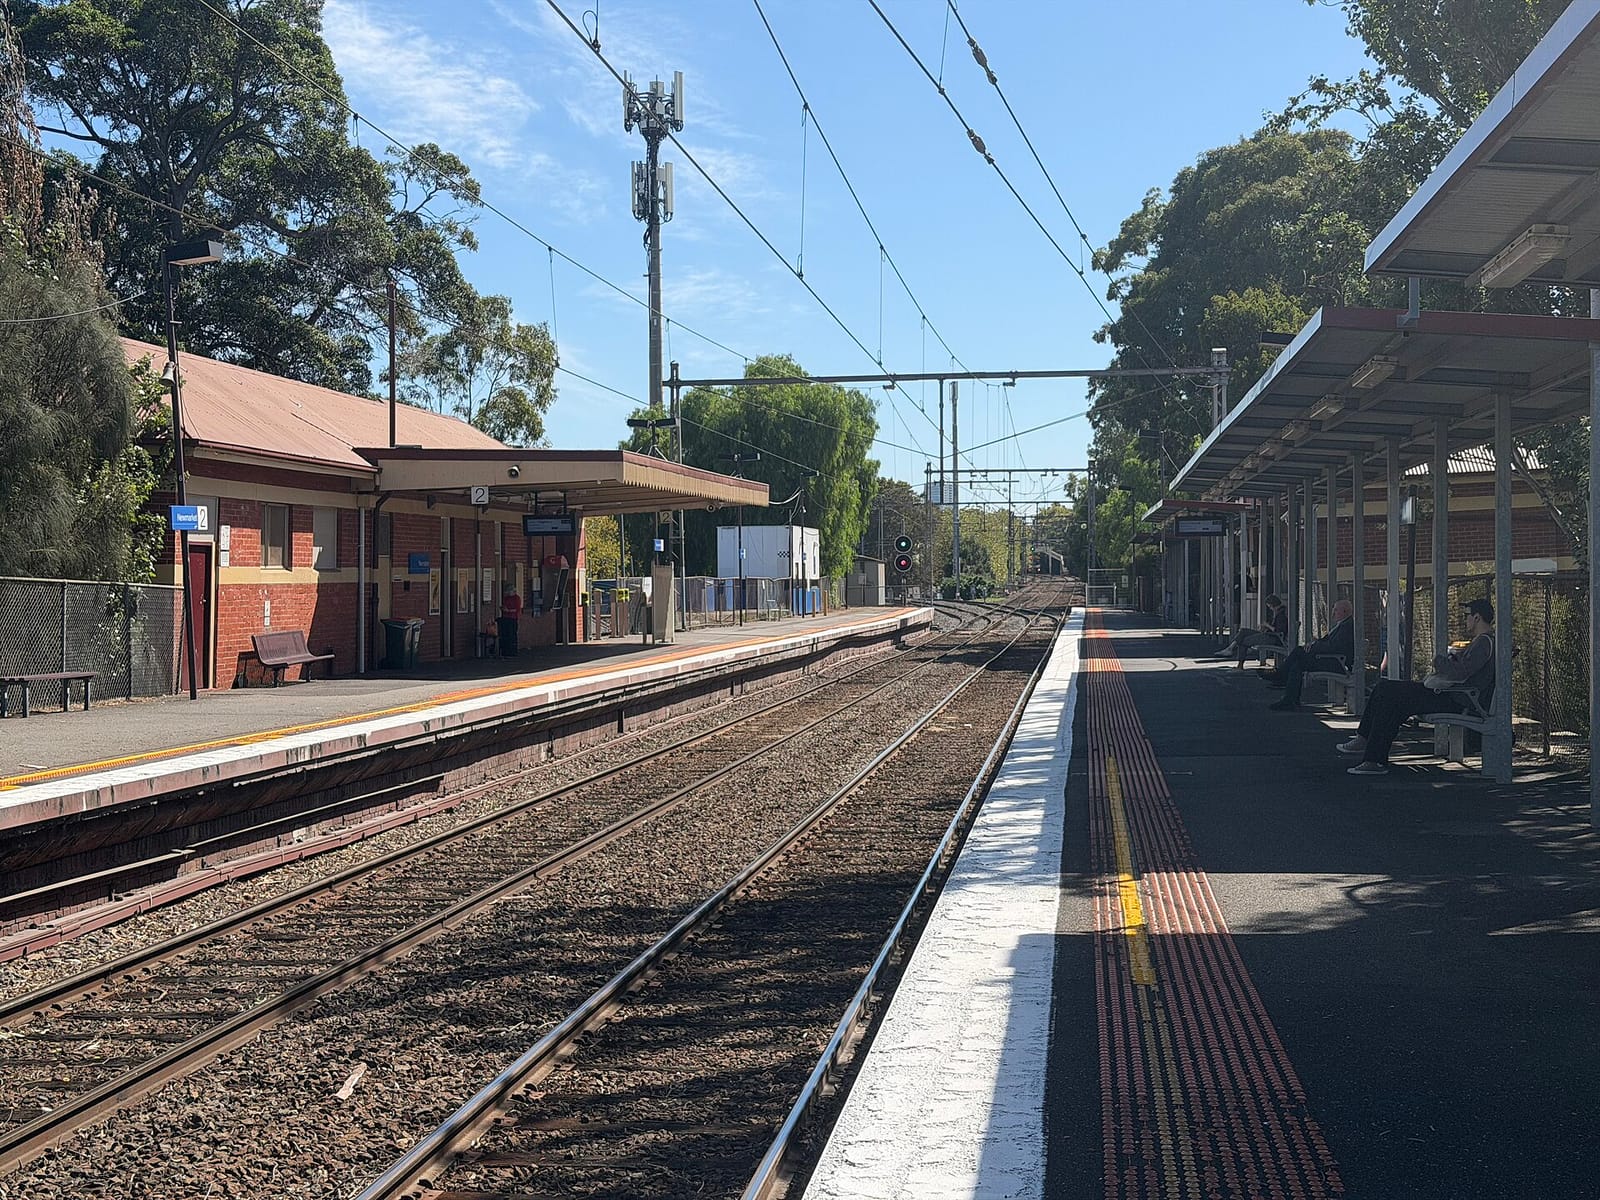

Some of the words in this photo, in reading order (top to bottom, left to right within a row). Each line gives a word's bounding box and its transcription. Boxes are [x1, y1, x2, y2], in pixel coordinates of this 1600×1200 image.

[475, 487, 485, 503] 2
[199, 508, 206, 528] 2
[662, 511, 670, 523] 2
